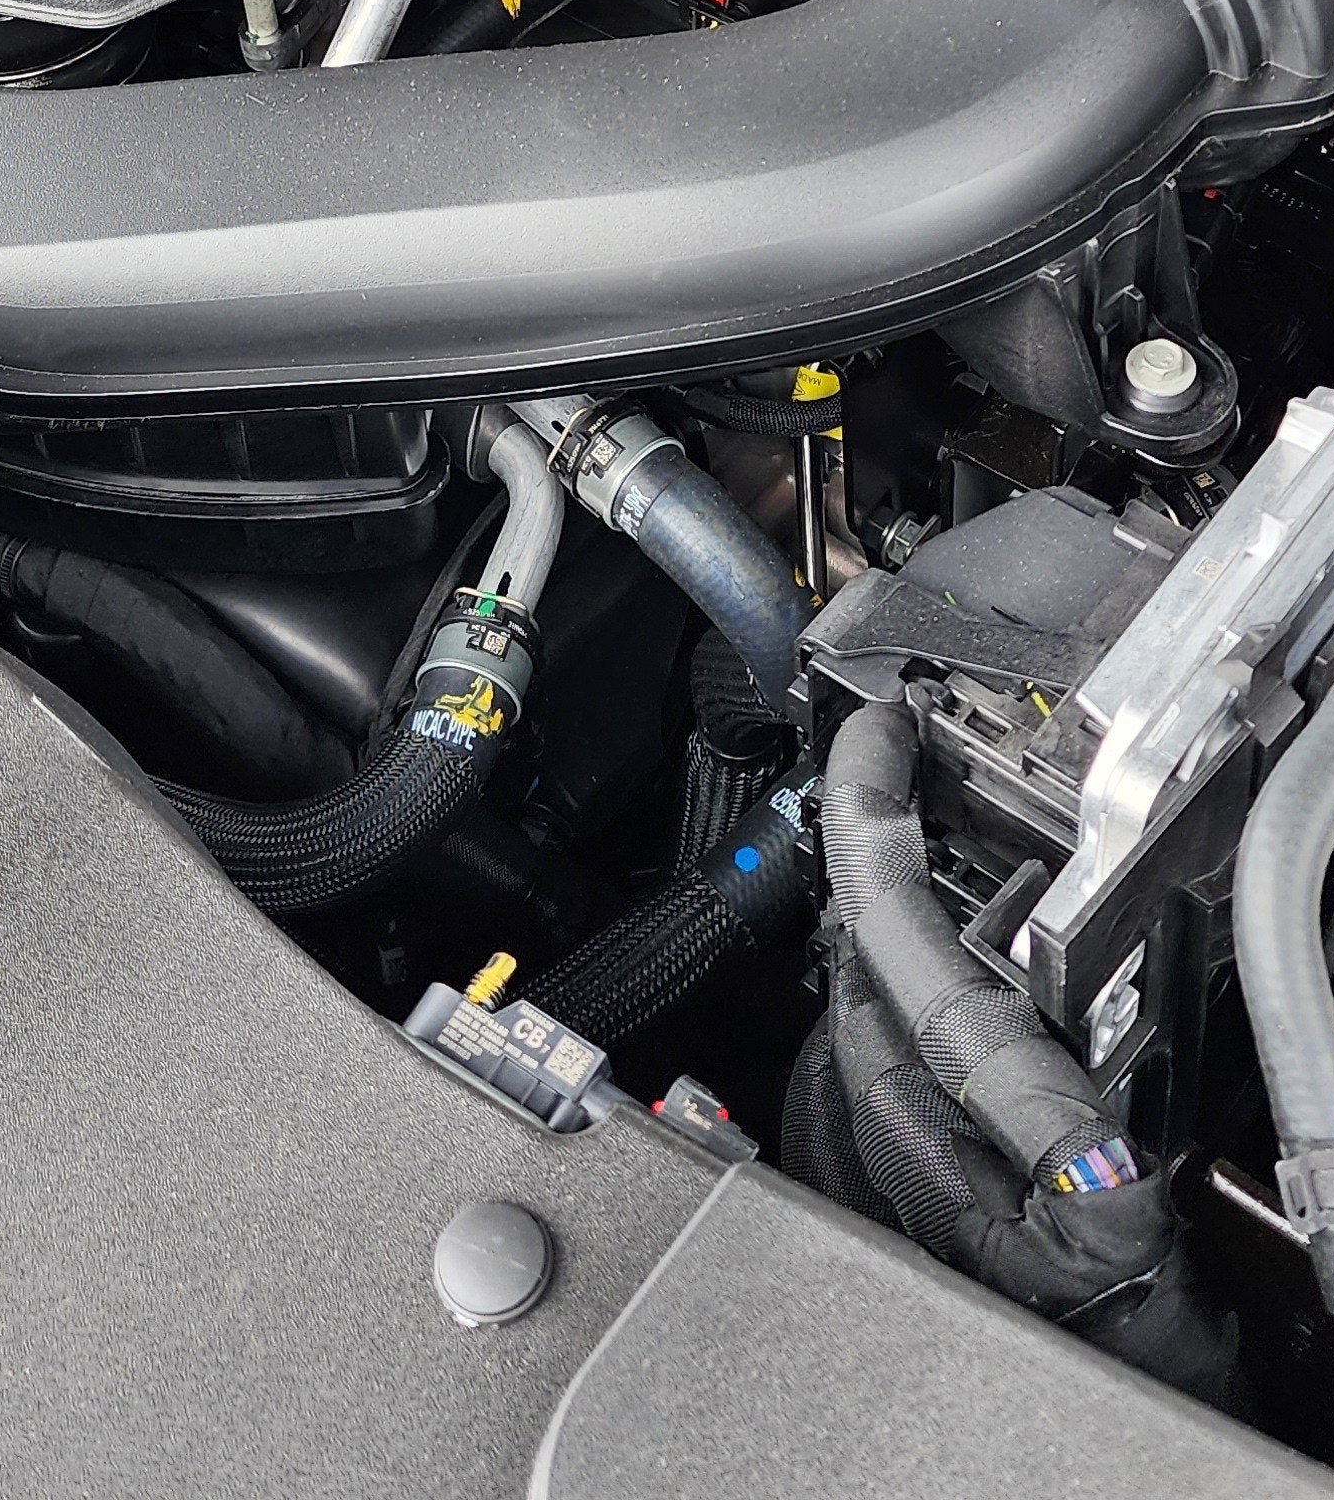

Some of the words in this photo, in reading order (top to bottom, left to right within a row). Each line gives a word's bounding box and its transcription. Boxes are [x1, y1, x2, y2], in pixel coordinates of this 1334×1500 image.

[411, 708, 448, 740] WCAC
[445, 717, 478, 751] PIPE
[511, 1018, 547, 1049] CB
